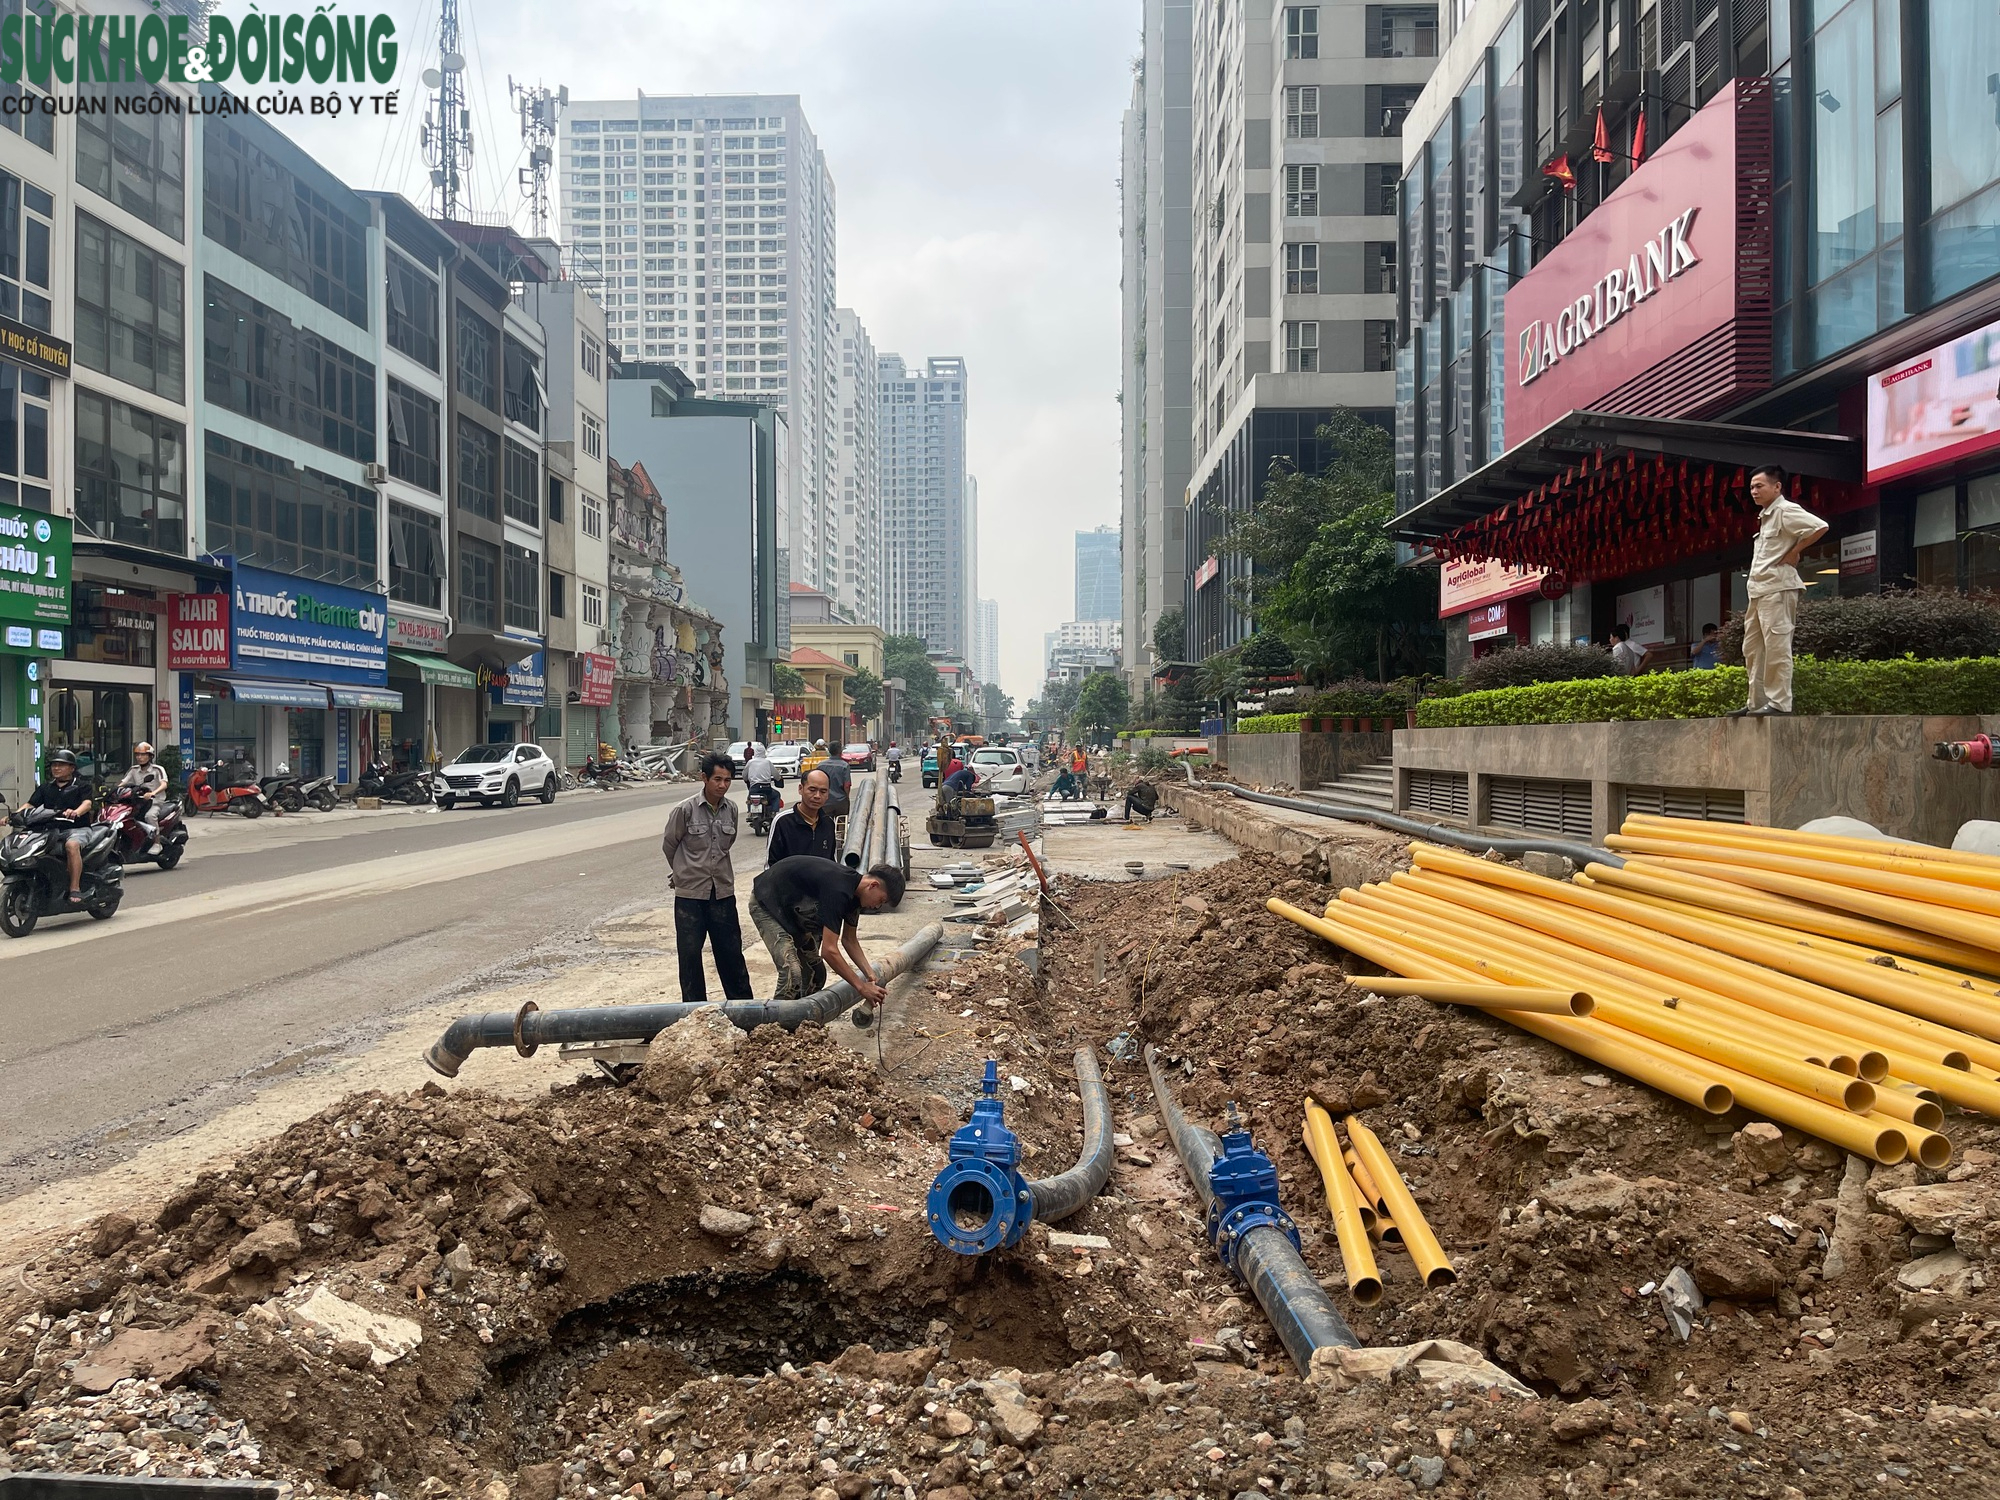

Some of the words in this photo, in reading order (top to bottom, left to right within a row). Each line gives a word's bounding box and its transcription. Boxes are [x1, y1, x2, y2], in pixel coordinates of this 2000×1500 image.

[1539, 207, 1701, 372] AGRIBANK
[1, 328, 6, 344] Y
[8, 332, 25, 352] HỌC
[27, 336, 38, 356] CỔ
[1890, 362, 1929, 384] AGRIBANK
[45, 556, 57, 578] 1
[1447, 564, 1486, 587] AgriGlobal
[180, 599, 218, 621] HAIR
[246, 590, 297, 619] THUỐC
[297, 592, 385, 639] Pharmacity
[118, 617, 133, 628] HAIR
[135, 619, 155, 631] SALON
[172, 628, 225, 651] SALON
[259, 630, 275, 641] THEO
[173, 657, 180, 665] 63
